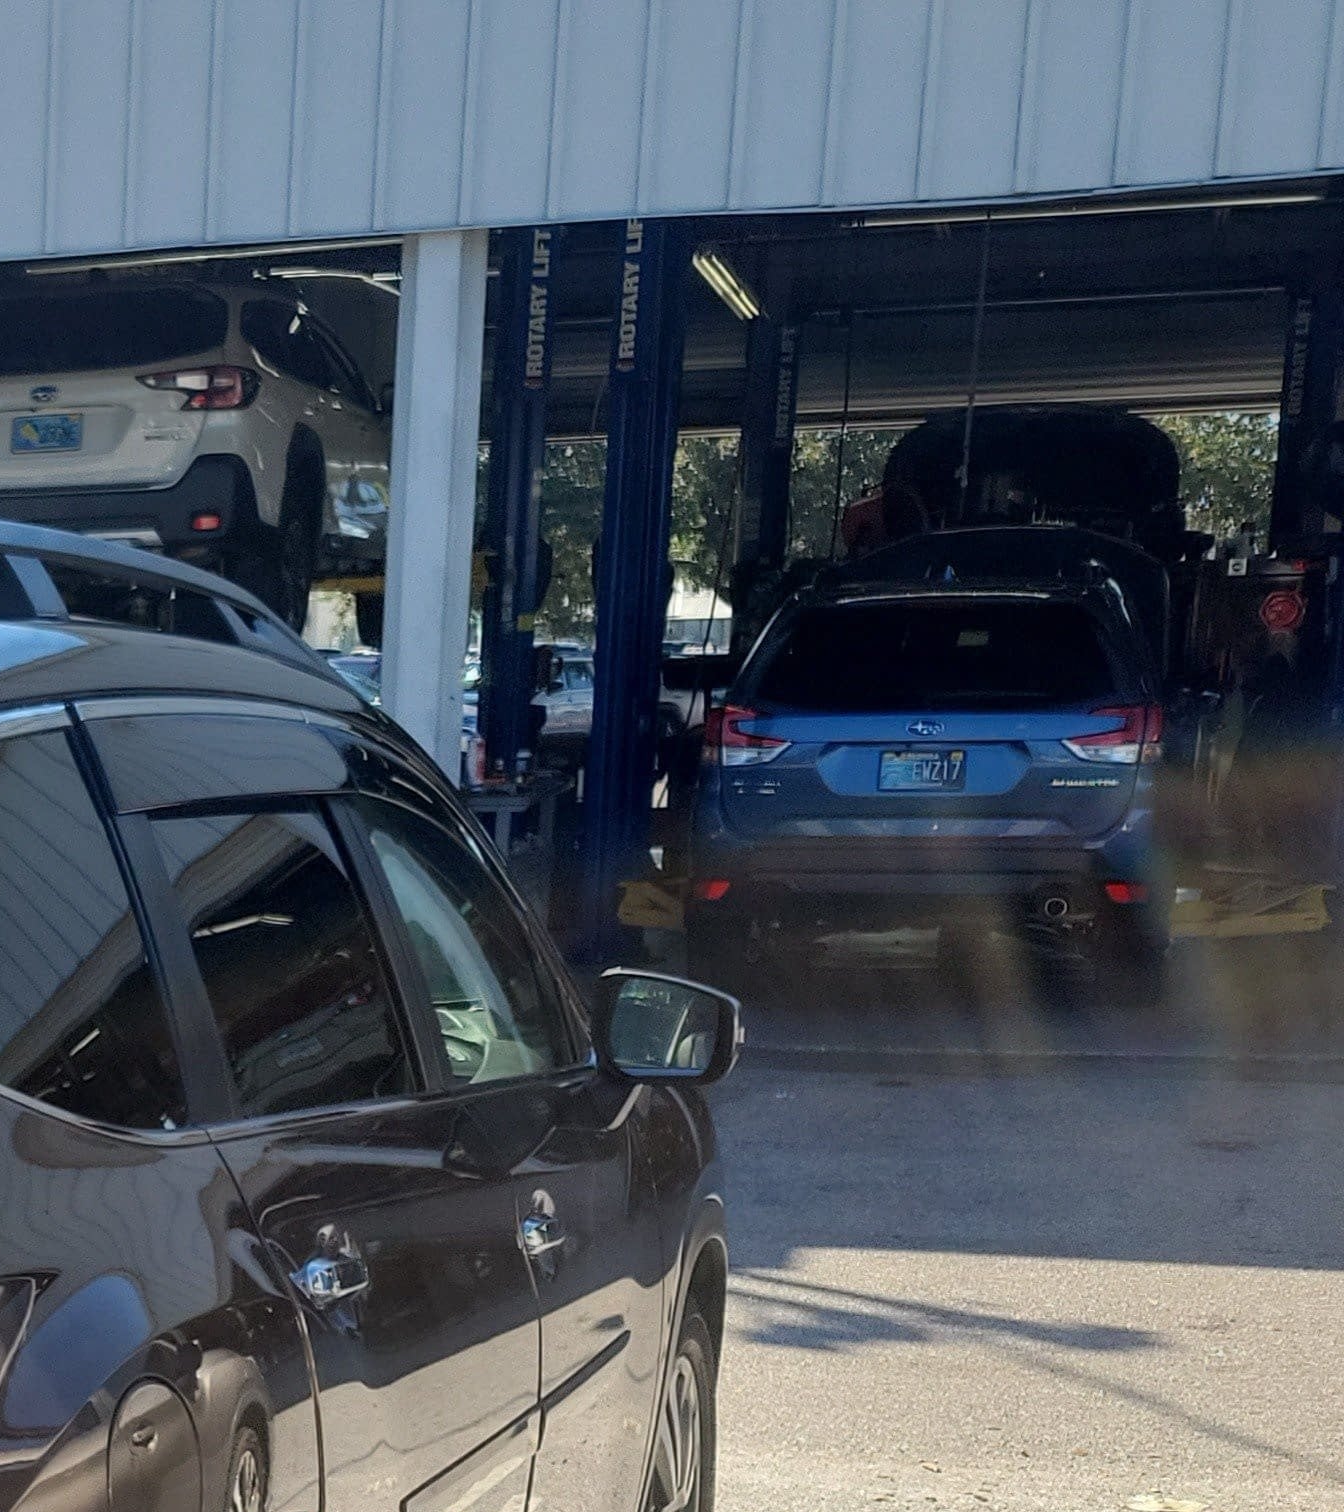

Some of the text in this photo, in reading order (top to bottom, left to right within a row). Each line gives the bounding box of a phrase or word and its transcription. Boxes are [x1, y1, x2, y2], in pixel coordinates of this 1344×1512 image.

[525, 229, 552, 377] ROTARY LIFT
[619, 218, 644, 358] ROTARY LIF
